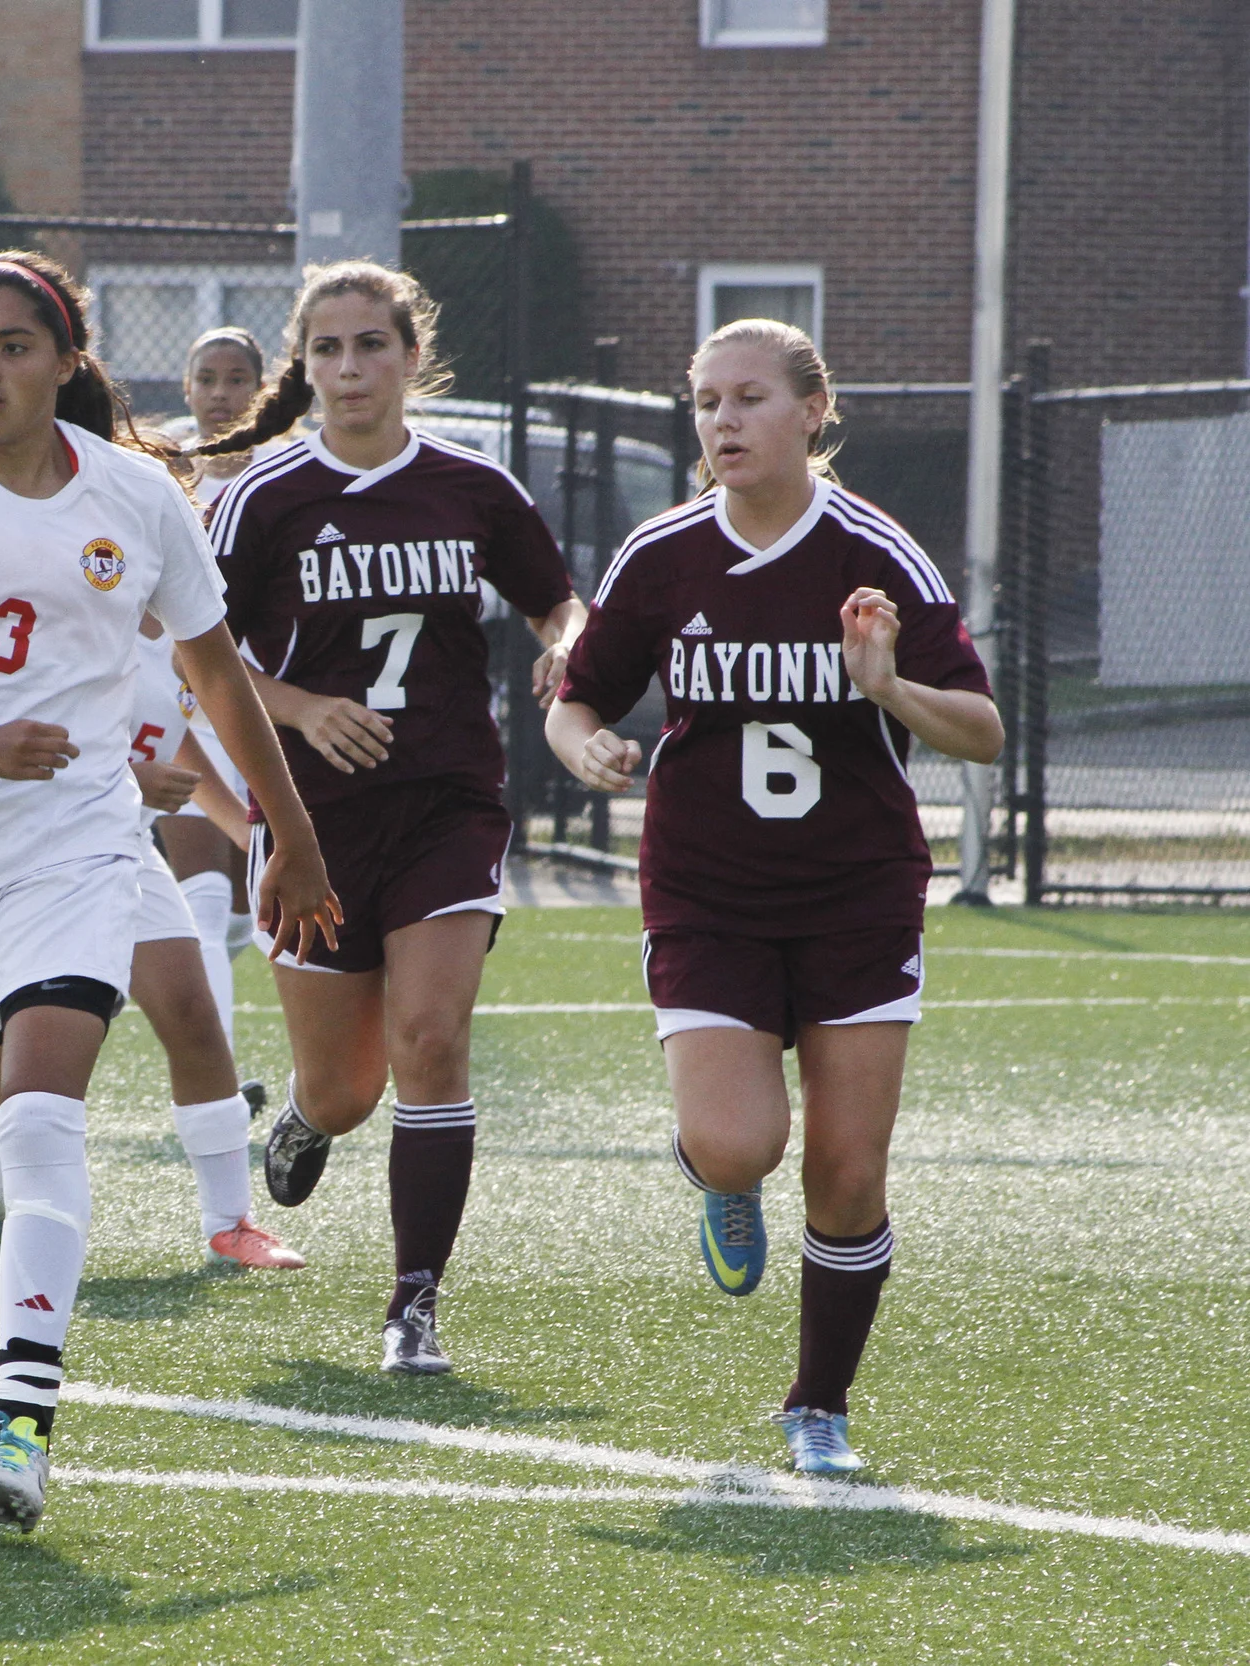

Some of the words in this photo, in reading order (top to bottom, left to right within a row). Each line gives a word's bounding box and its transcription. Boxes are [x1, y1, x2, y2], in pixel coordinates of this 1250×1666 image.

[315, 533, 346, 545] adidas
[298, 540, 478, 603] BAYONNE
[361, 613, 425, 710] 7
[681, 626, 713, 636] adidas
[670, 638, 866, 703] BAYONN
[741, 720, 822, 819] 6
